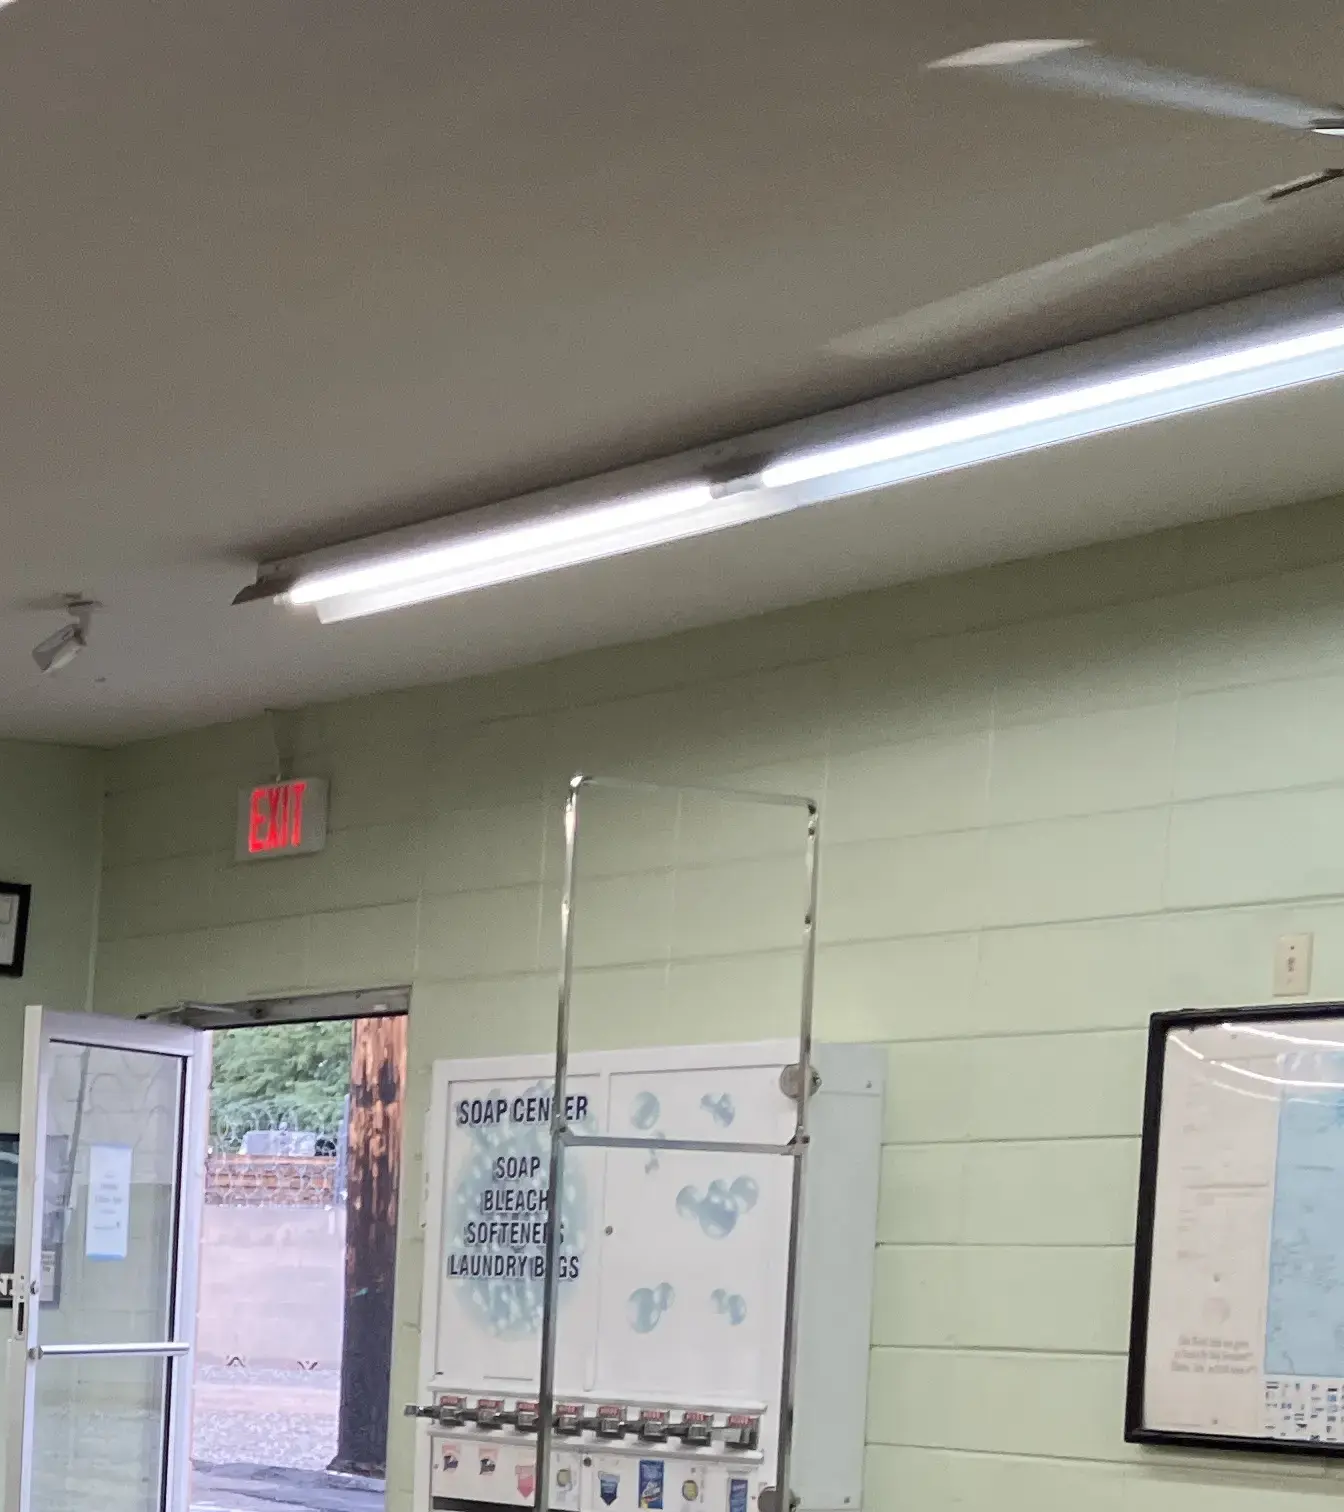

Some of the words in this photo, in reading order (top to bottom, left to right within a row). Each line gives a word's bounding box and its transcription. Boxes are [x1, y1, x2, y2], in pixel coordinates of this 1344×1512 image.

[249, 781, 307, 853] EXIT
[459, 1099, 508, 1124] SOAP
[513, 1096, 588, 1122] CENER
[495, 1156, 540, 1179] SOAP
[483, 1188, 549, 1211] BLEACH
[450, 1254, 527, 1277] LAUNDRY
[535, 1255, 580, 1278] BGS
